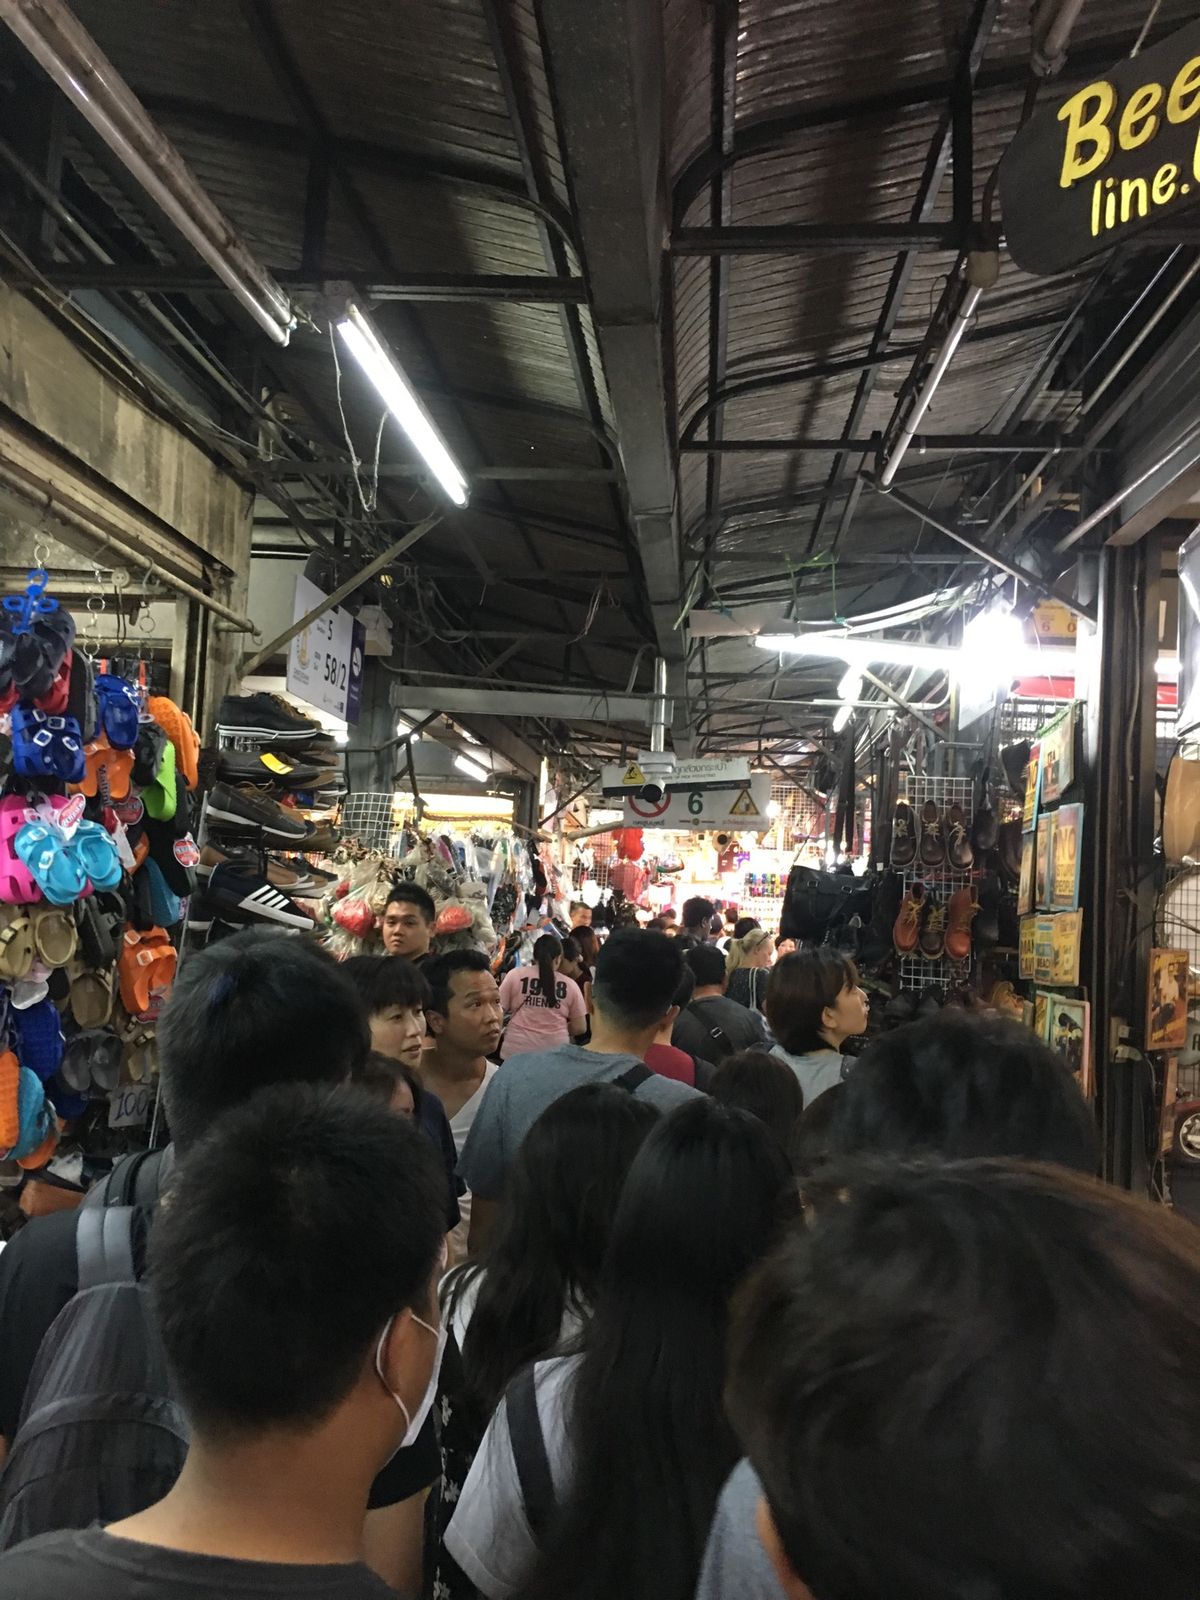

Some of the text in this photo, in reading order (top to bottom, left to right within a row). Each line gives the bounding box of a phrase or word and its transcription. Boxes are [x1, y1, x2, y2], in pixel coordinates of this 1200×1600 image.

[1092, 128, 1200, 237] line.
[327, 619, 333, 641] 5
[324, 653, 347, 691] 58/2
[687, 791, 704, 815] 6
[520, 976, 567, 999] 198
[114, 1089, 149, 1121] 100
